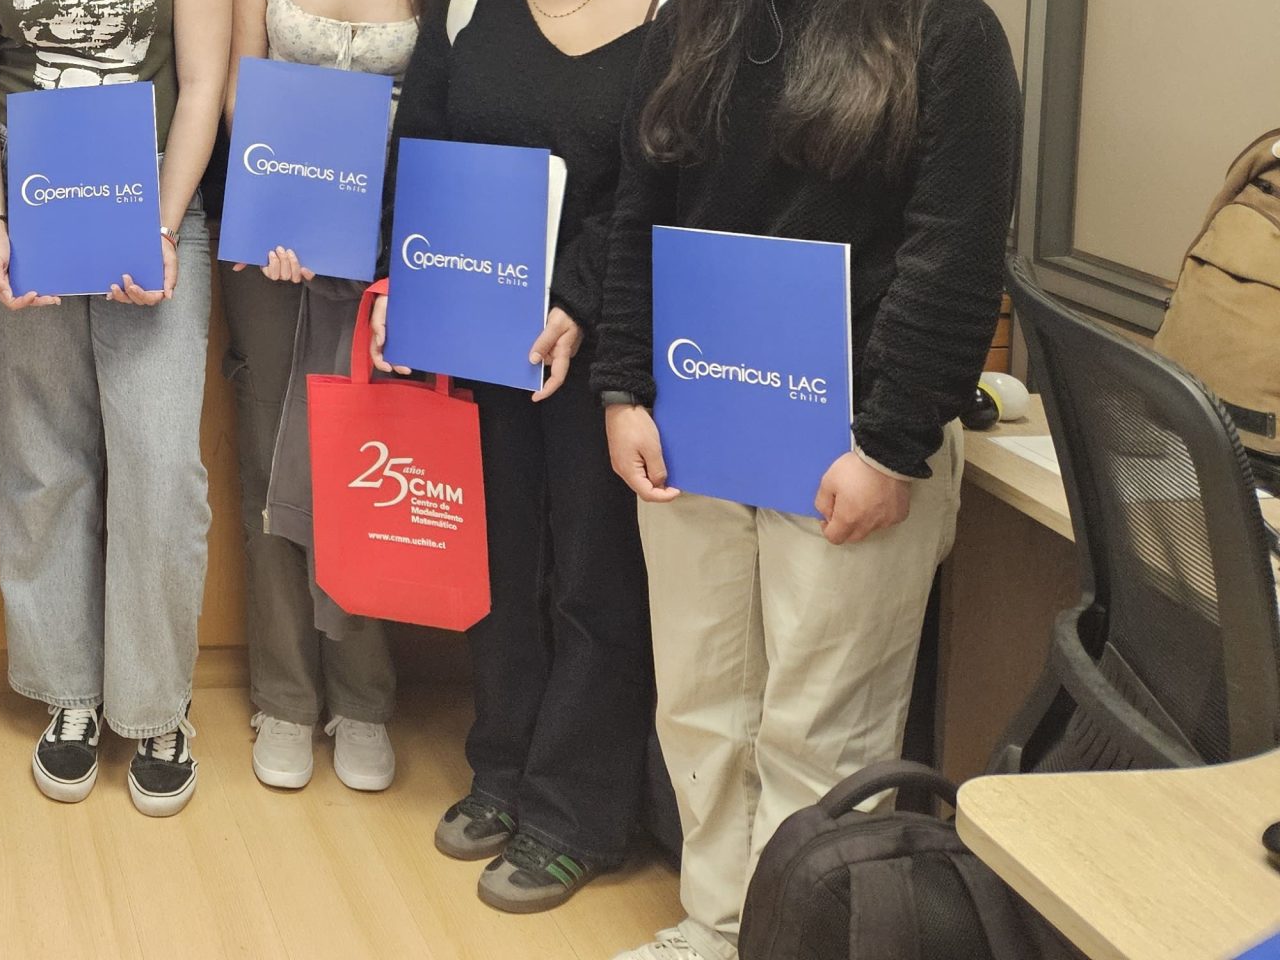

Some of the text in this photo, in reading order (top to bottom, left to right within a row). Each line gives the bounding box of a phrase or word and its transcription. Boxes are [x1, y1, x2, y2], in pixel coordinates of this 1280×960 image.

[243, 143, 369, 186] Copernicus LAC
[21, 174, 144, 207] Copernicus LAC
[338, 184, 368, 194] Chile
[401, 233, 529, 279] Copernicus LAC
[497, 276, 529, 288] Chile
[667, 338, 828, 394] Copernicus LAC
[789, 391, 828, 404] Chile
[348, 441, 414, 507] 25
[402, 464, 426, 476] años
[409, 478, 464, 505] CMM
[410, 497, 451, 511] Centro de
[410, 506, 464, 523] Modelamiento
[410, 515, 458, 531] Matemático
[368, 532, 447, 550] www.cmm.uchile.cl
